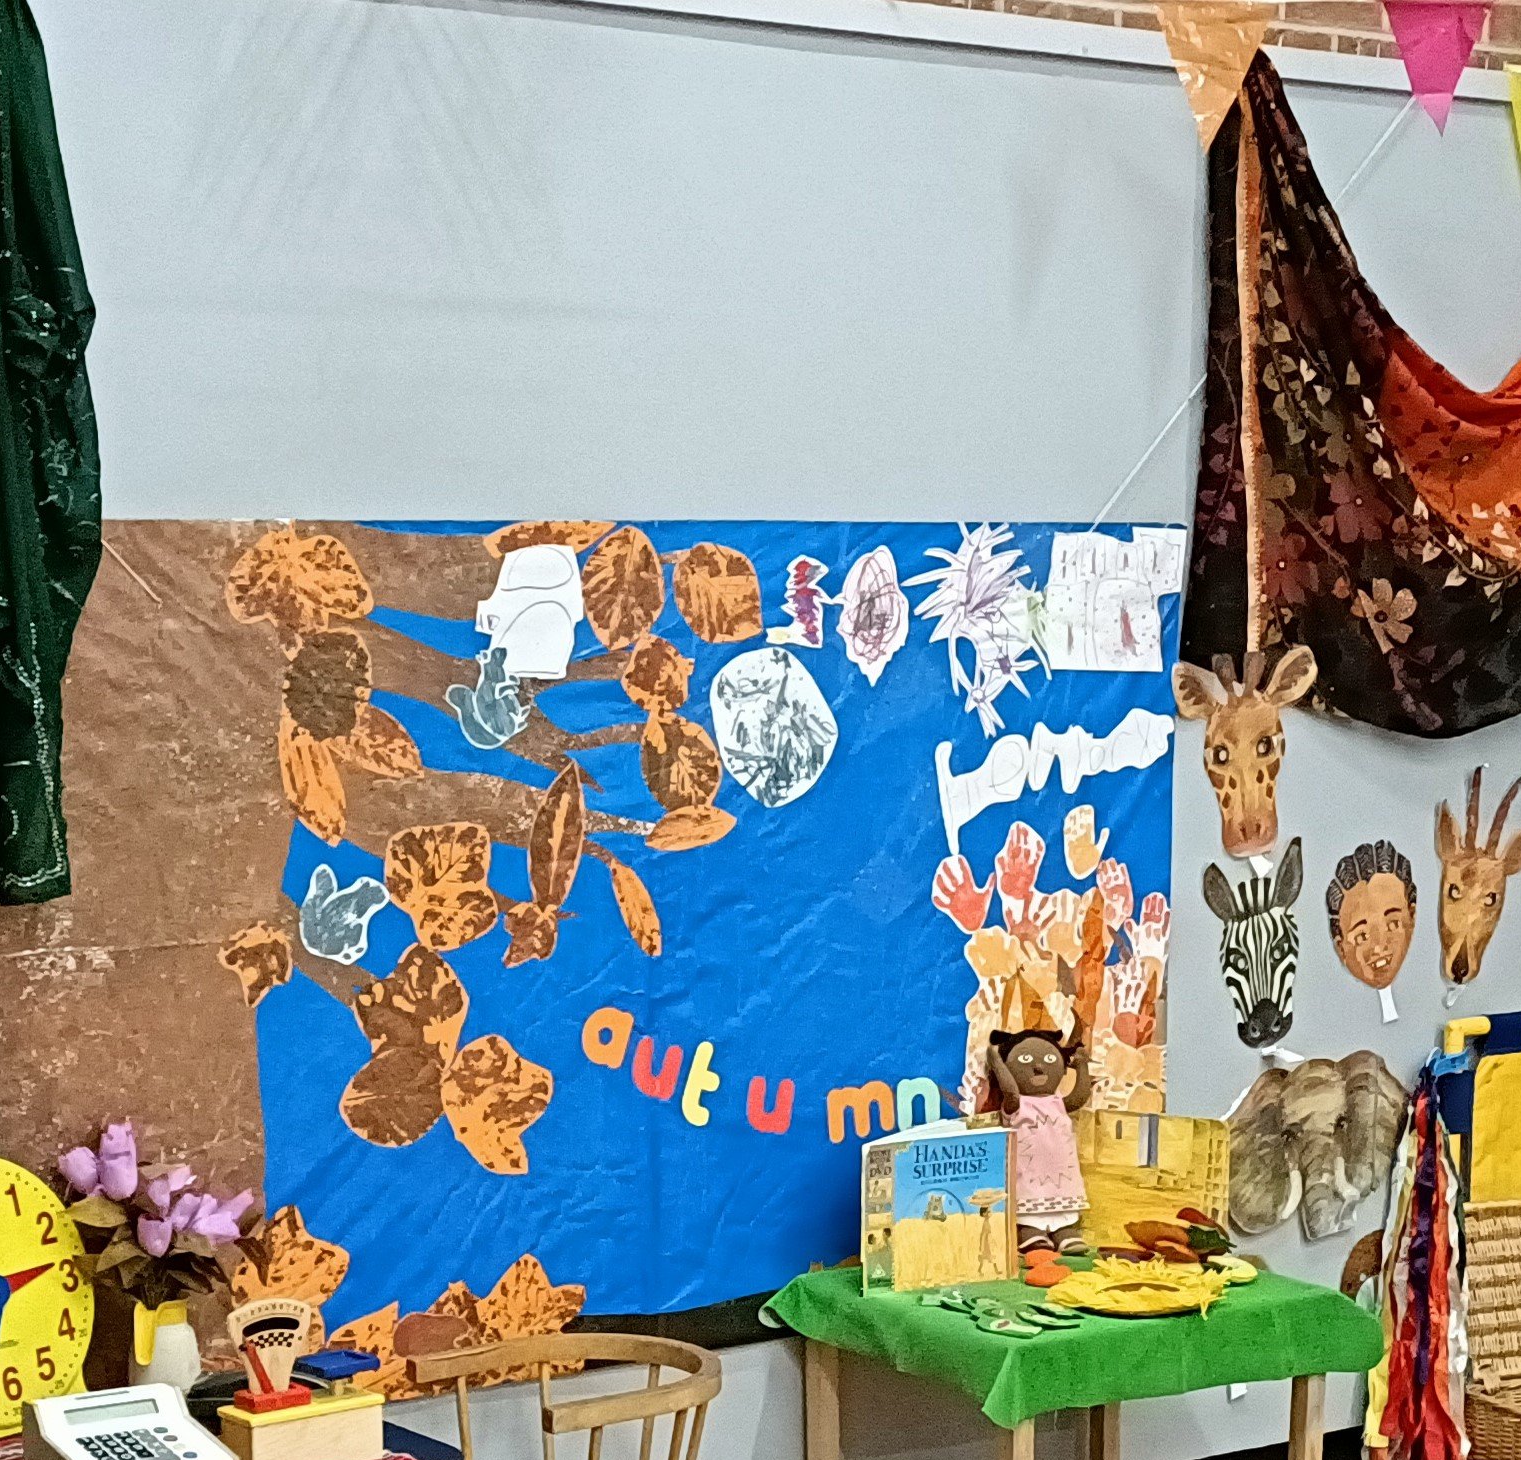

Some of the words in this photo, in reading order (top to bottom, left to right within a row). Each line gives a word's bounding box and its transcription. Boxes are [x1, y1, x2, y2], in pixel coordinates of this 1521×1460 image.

[912, 1158, 989, 1180] SURPRISE
[913, 1141, 987, 1164] HANDA'S
[4, 1183, 21, 1217] 1
[36, 1211, 58, 1245] 2
[58, 1258, 79, 1293] 3
[58, 1307, 76, 1341] 4
[36, 1345, 56, 1381] 5
[2, 1366, 23, 1401] 6
